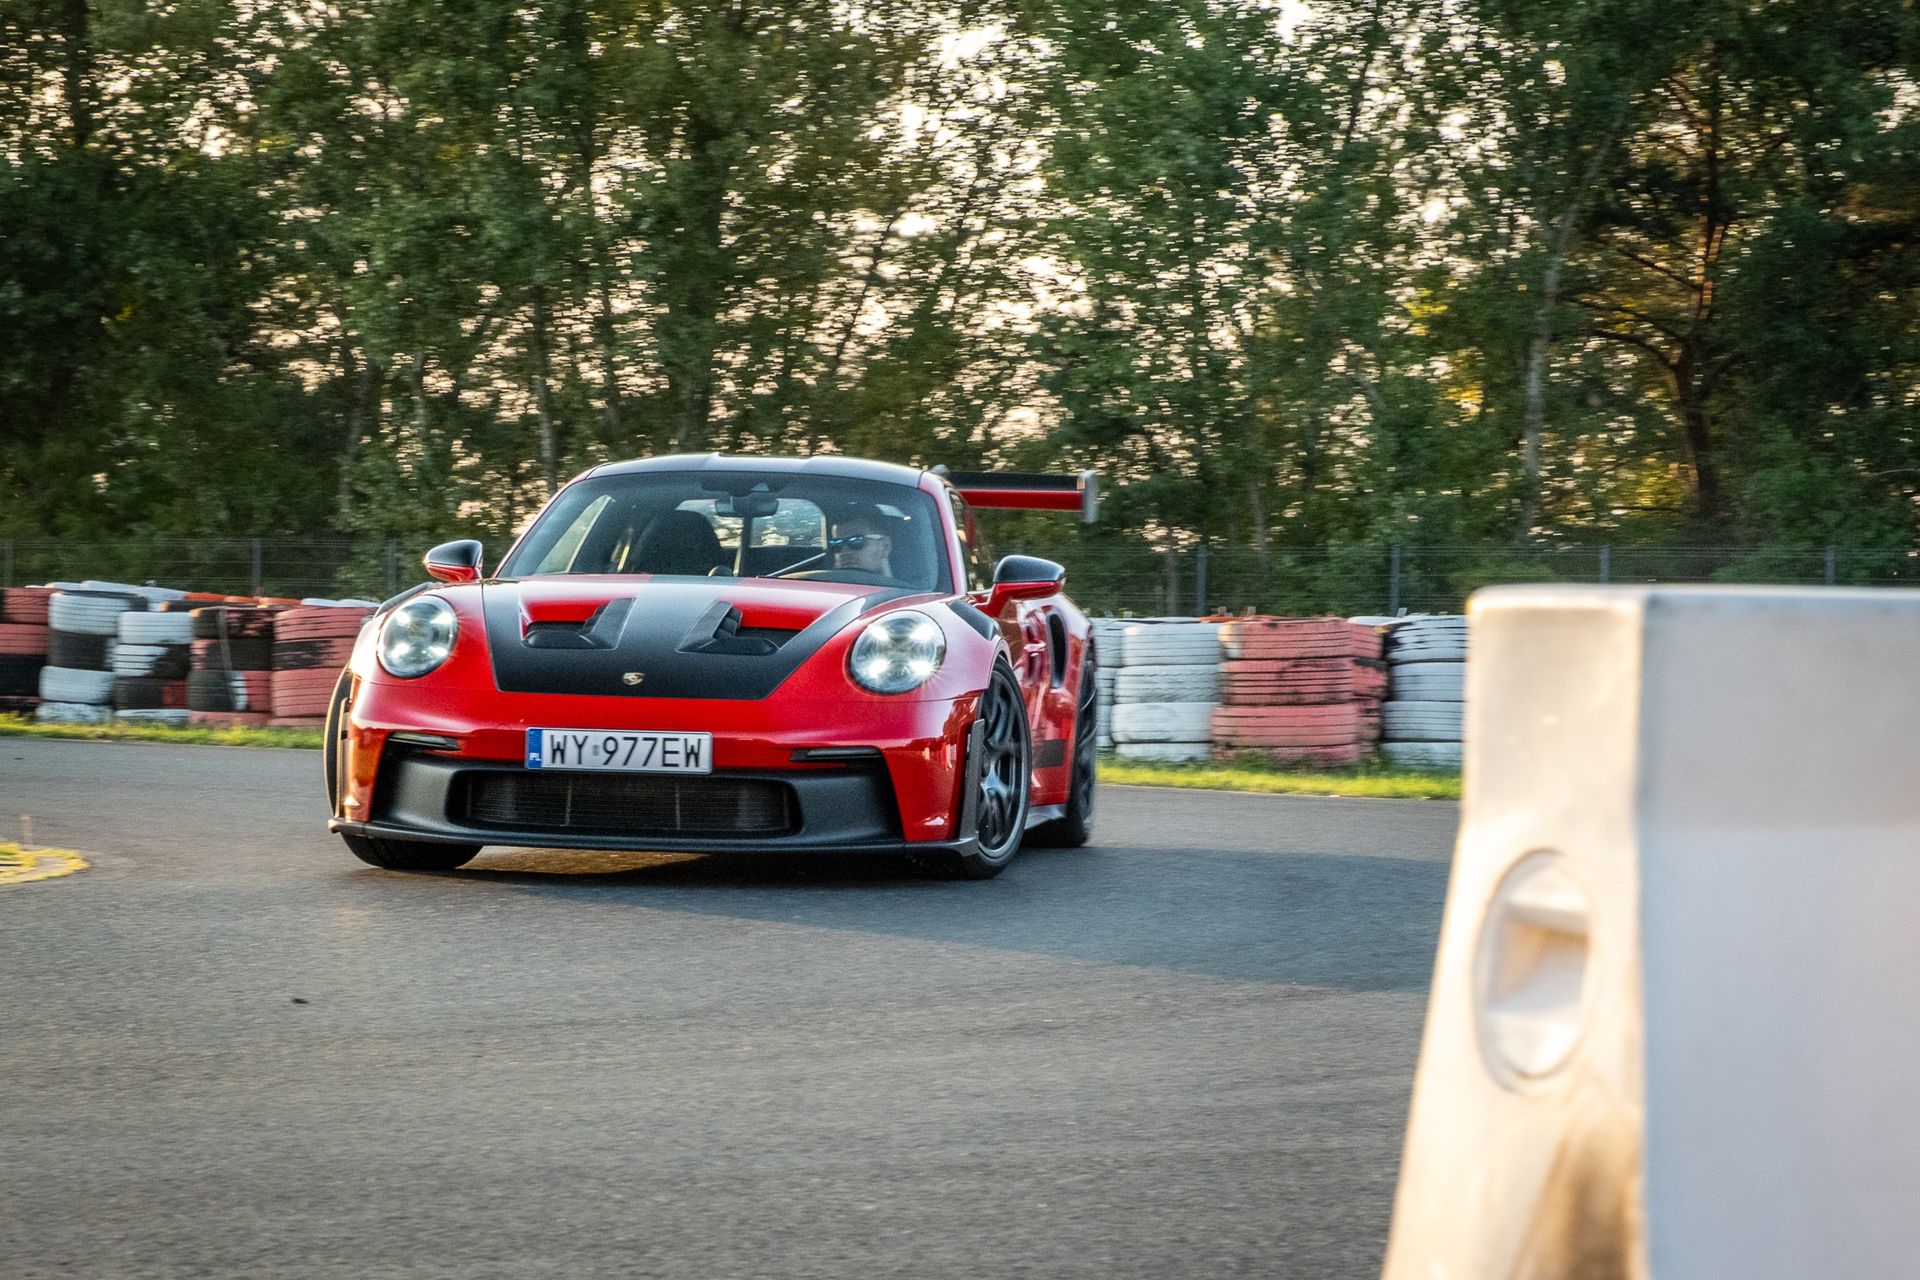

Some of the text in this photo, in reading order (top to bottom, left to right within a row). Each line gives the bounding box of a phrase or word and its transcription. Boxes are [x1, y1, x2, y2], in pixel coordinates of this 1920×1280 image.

[529, 752, 541, 761] PL
[551, 735, 701, 768] WY 977EW
